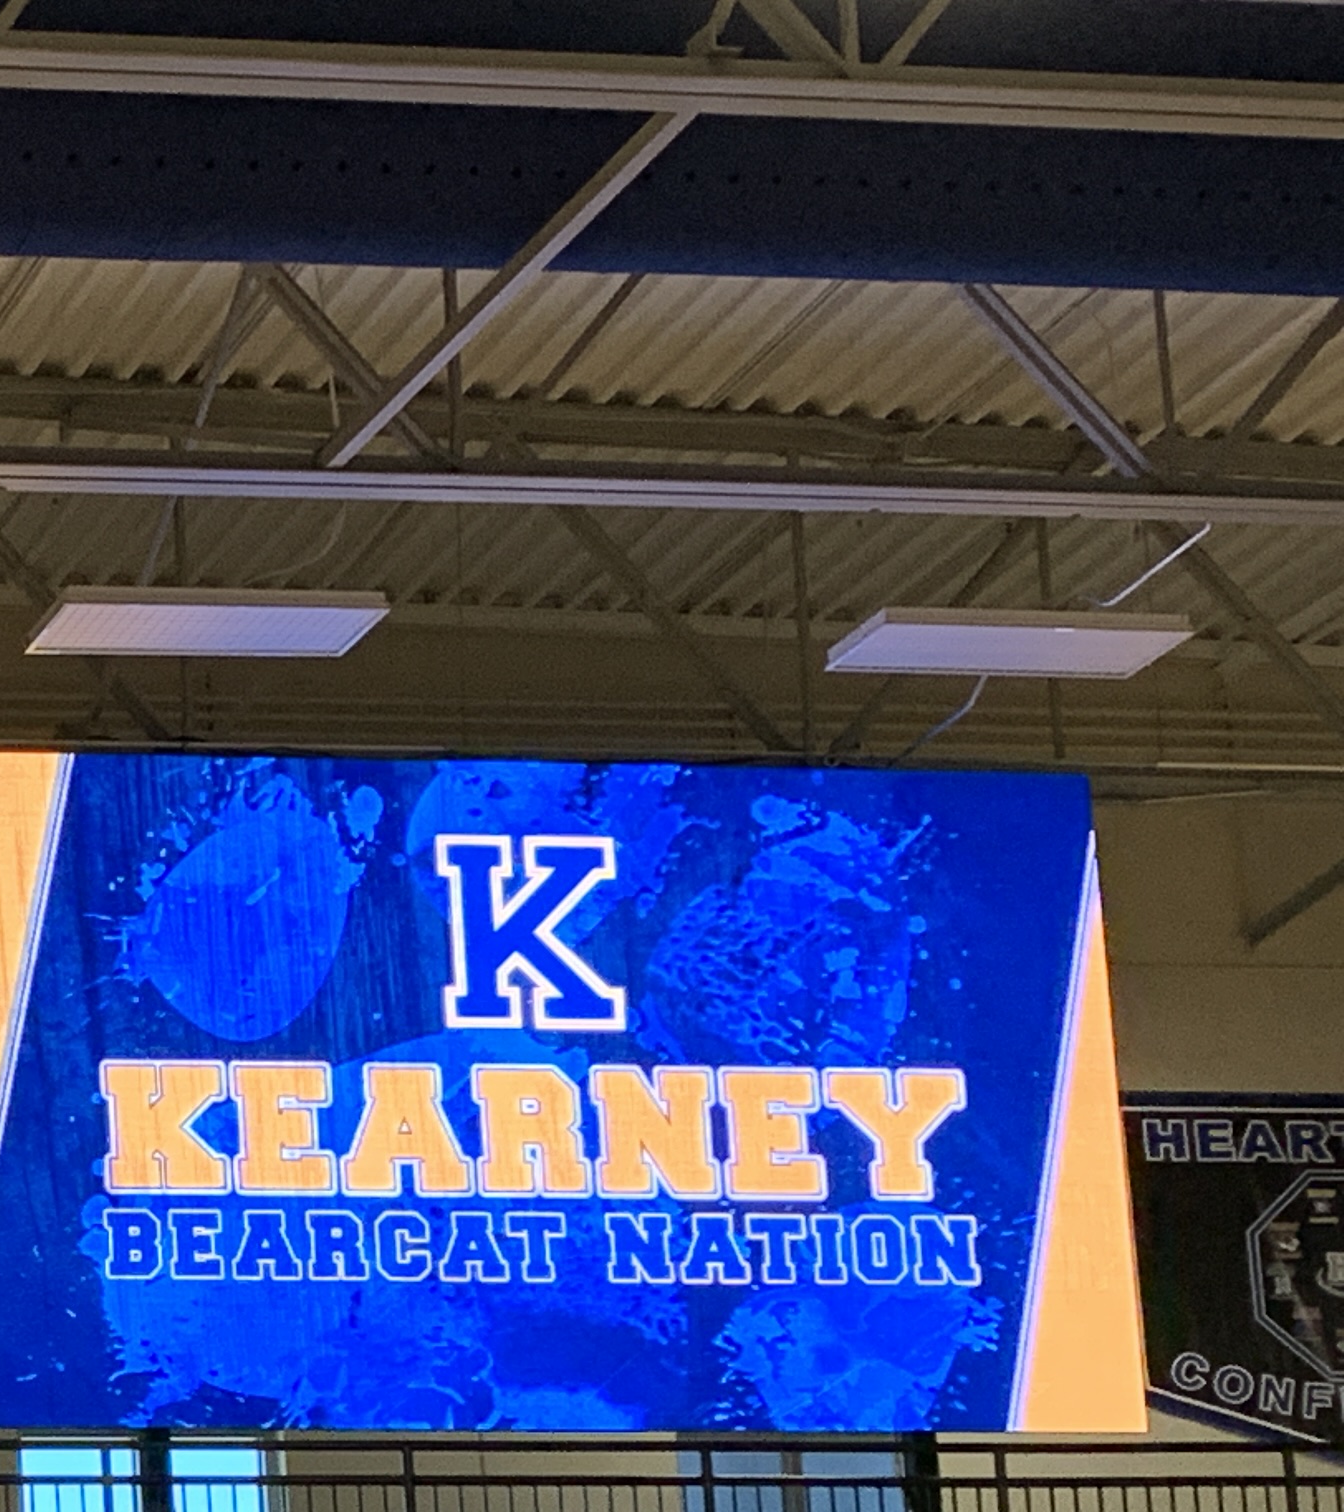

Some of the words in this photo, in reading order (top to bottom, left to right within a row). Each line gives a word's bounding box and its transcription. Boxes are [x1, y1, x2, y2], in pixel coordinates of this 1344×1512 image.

[435, 833, 627, 1030] K
[99, 1059, 967, 1202] KEARNEY
[103, 1208, 567, 1284] BEARCAT
[605, 1212, 984, 1288] NATION
[1171, 1352, 1344, 1420] CONF
